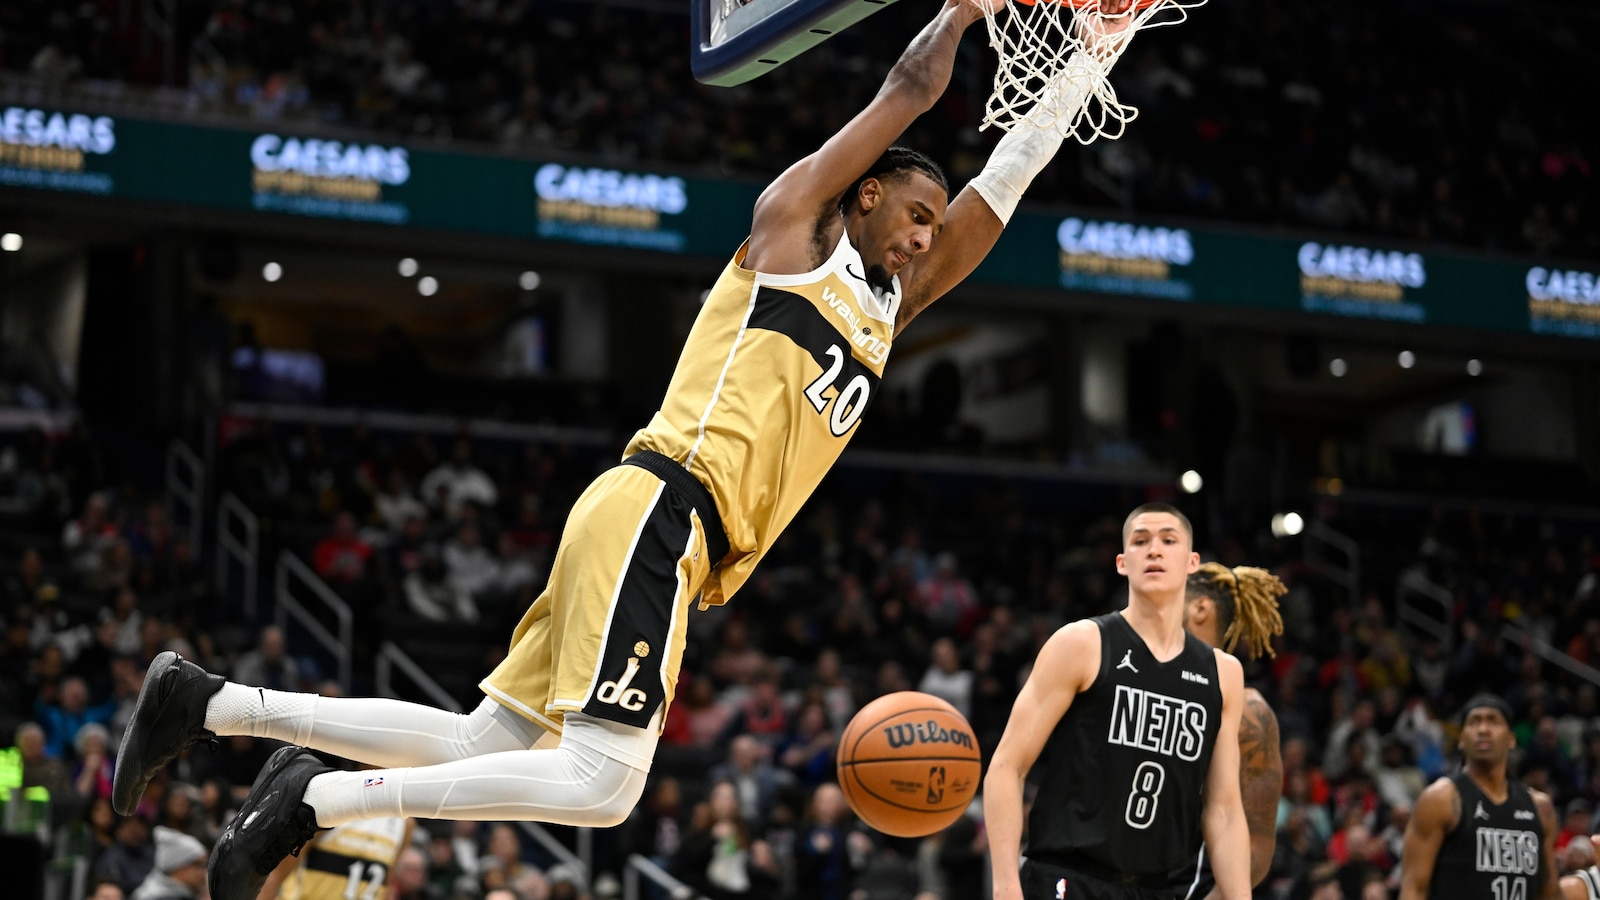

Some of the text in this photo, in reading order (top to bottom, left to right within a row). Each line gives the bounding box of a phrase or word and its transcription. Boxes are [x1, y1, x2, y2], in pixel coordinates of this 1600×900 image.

[0, 107, 115, 154] ESARS
[250, 133, 411, 186] CAESARS
[534, 163, 688, 215] CAESARS
[1057, 217, 1194, 266] CAESARS
[1297, 241, 1426, 288] CAESARS
[820, 286, 891, 366] washing
[803, 343, 871, 438] 20
[884, 720, 973, 750] Wilson
[1107, 684, 1207, 762] NETS
[1125, 760, 1165, 830] 8
[1475, 826, 1540, 876] NETS
